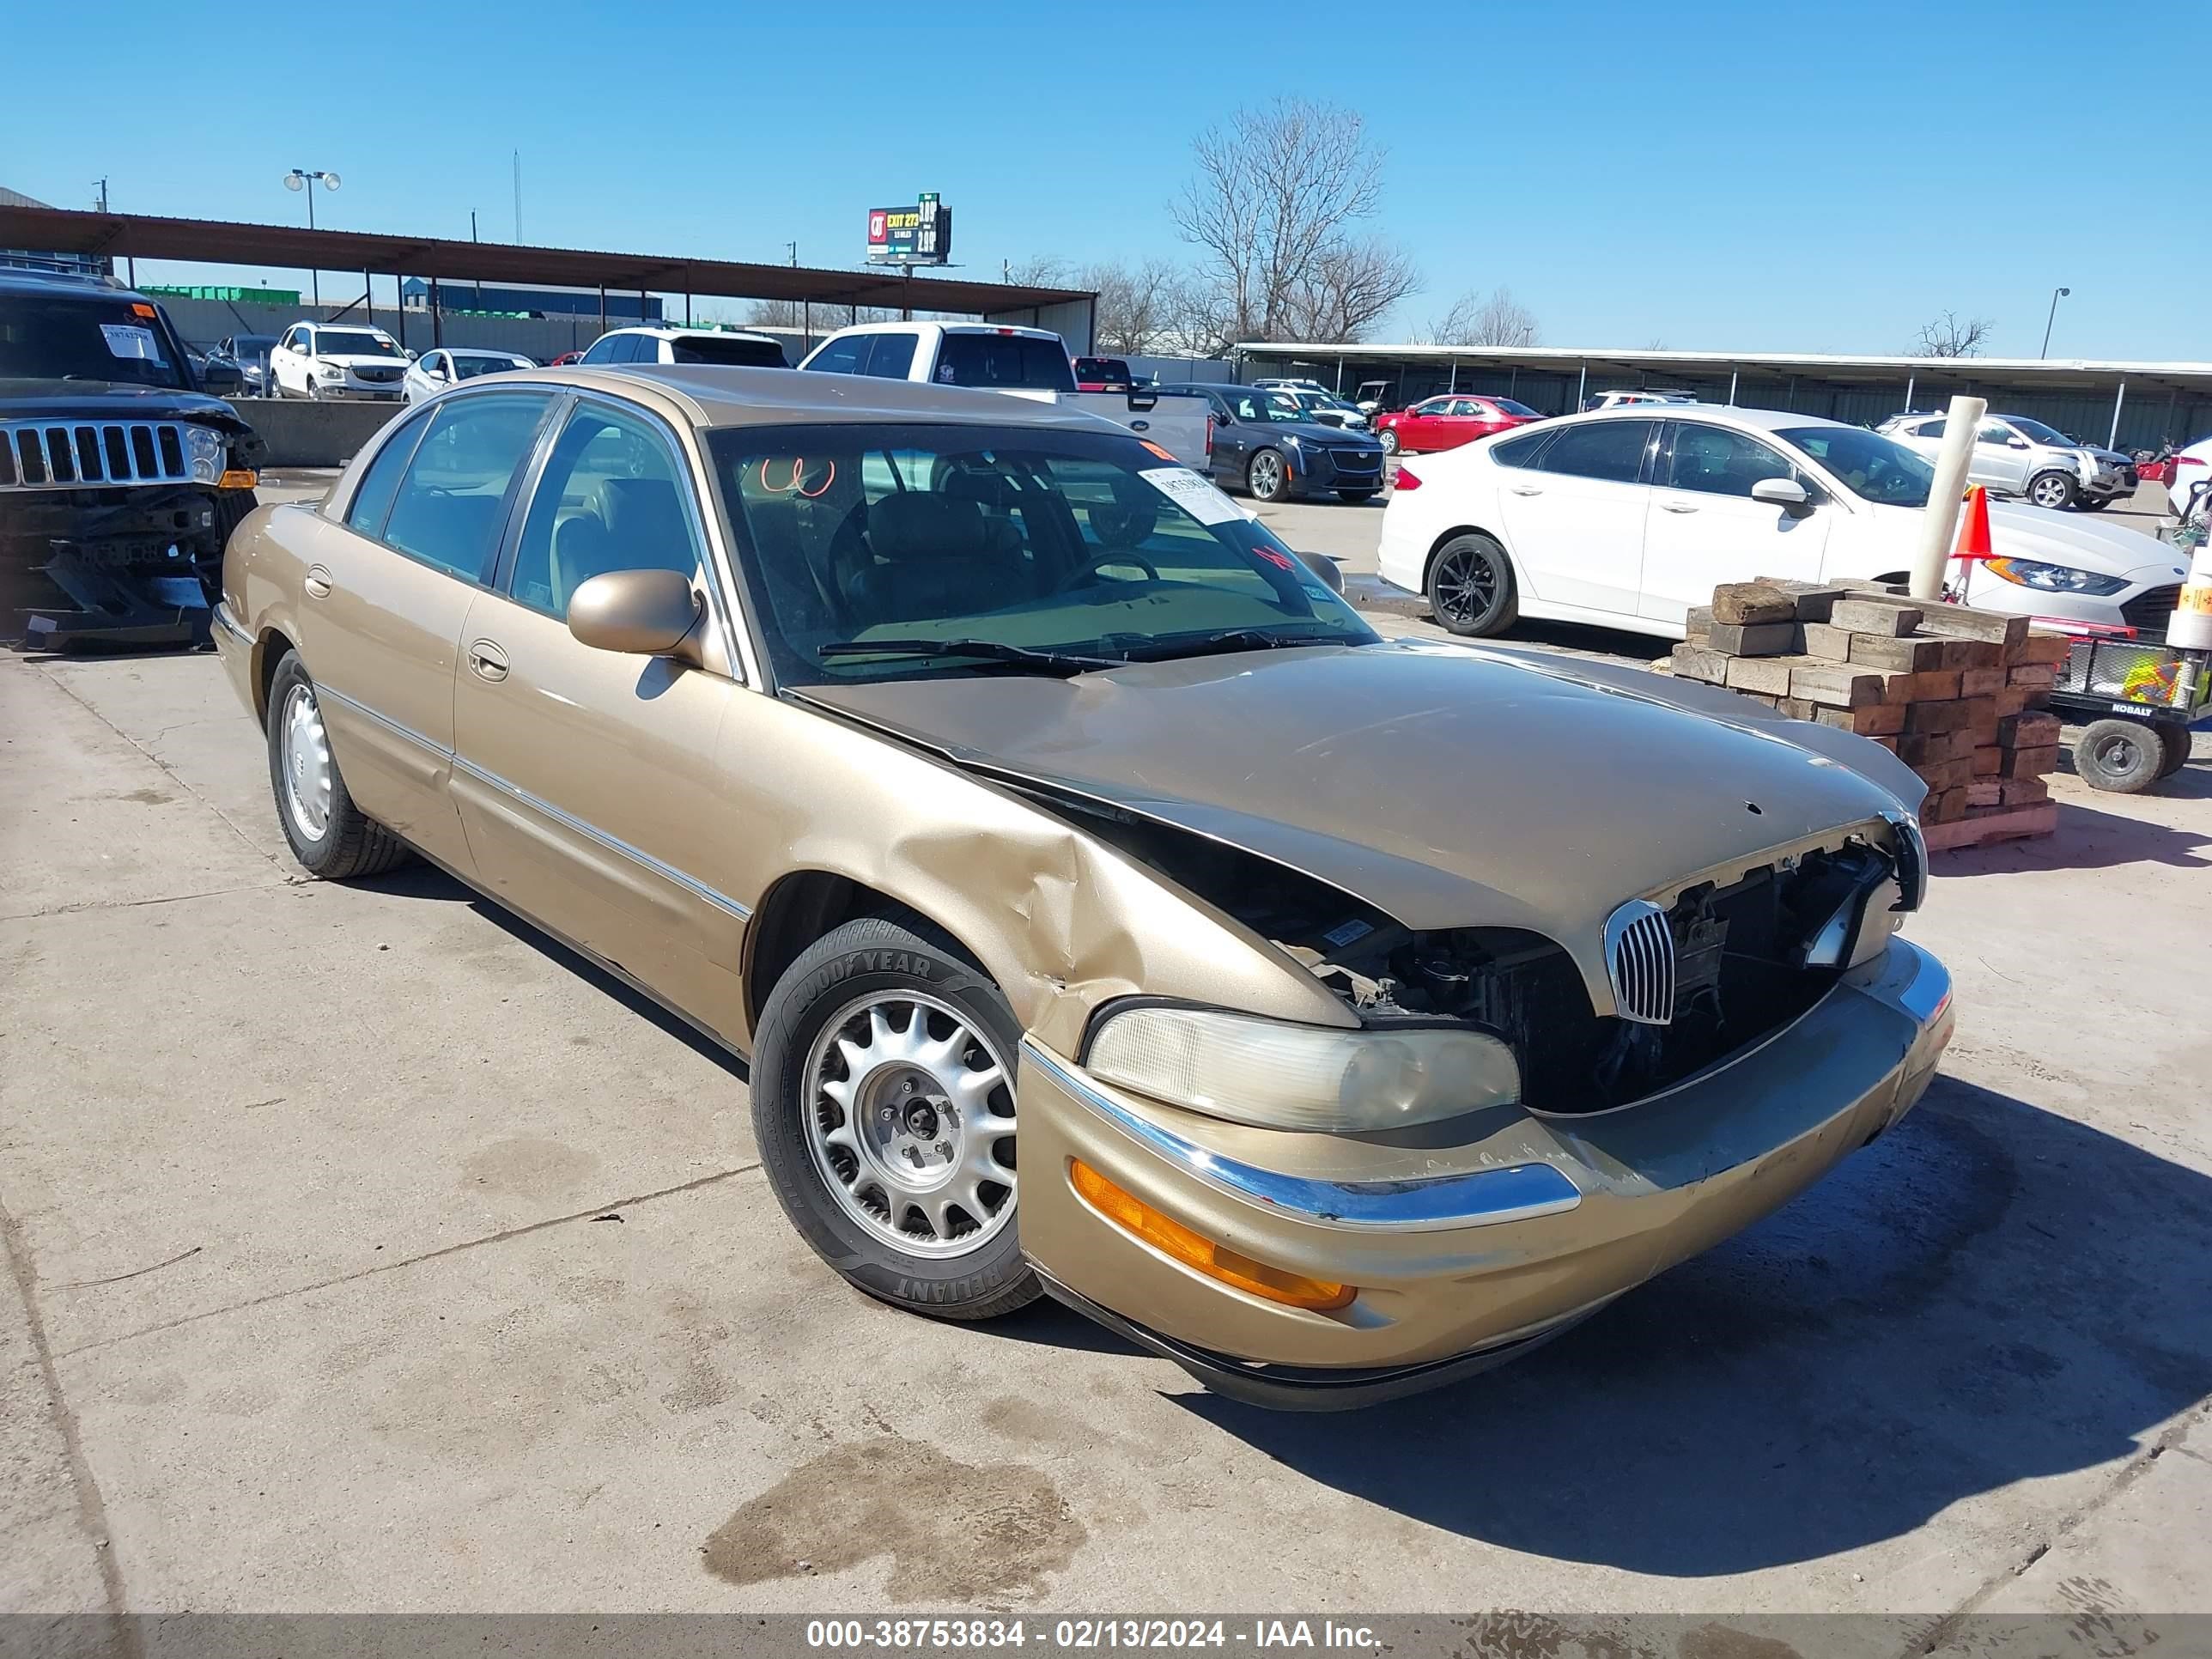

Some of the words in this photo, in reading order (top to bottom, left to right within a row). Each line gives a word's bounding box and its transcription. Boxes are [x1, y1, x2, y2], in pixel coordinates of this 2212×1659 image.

[871, 215, 884, 239] QT
[886, 213, 905, 228] EXIT
[904, 212, 919, 228] 273
[2112, 703, 2153, 717] KOBALT
[793, 951, 931, 1014] GOODYEAR
[893, 1264, 1003, 1302] RELIANT
